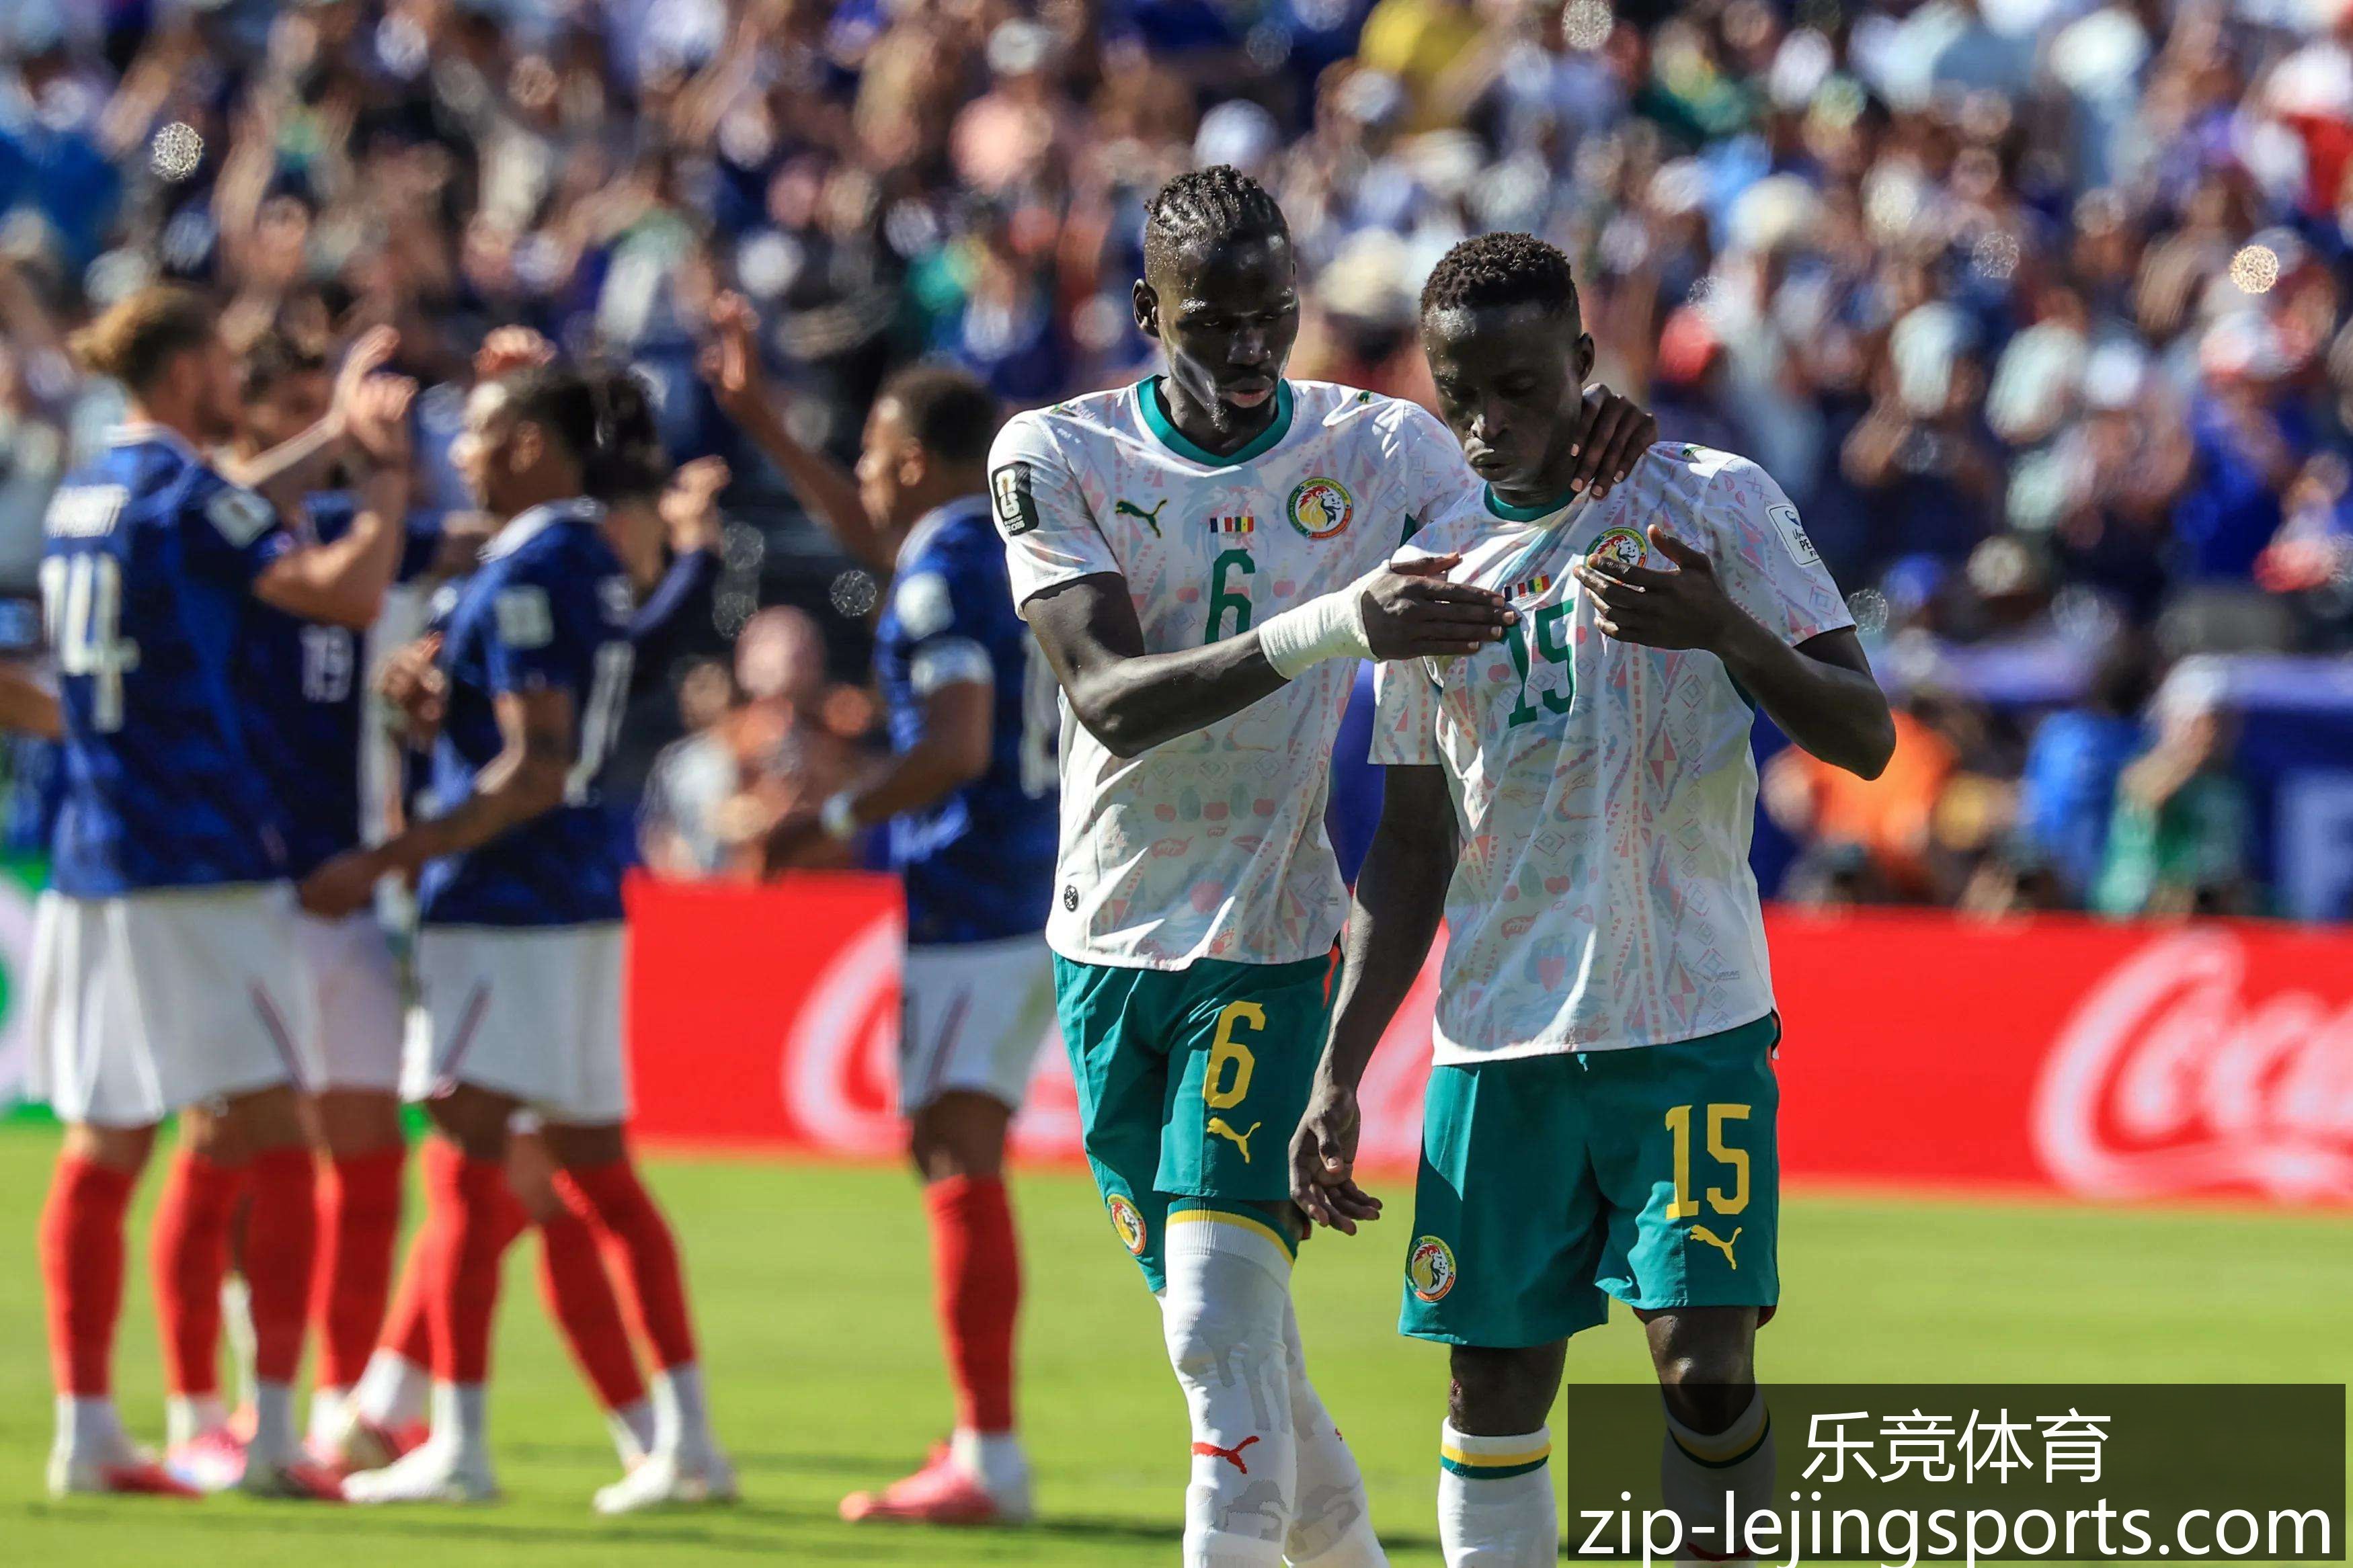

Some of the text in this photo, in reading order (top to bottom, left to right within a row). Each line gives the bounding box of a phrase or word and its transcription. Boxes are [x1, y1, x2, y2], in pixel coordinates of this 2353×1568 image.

[38, 554, 141, 734] 14
[1205, 549, 1256, 645] 6
[1497, 596, 1577, 729] 15
[1203, 1000, 1266, 1109] 6
[1665, 1104, 1751, 1221] 15
